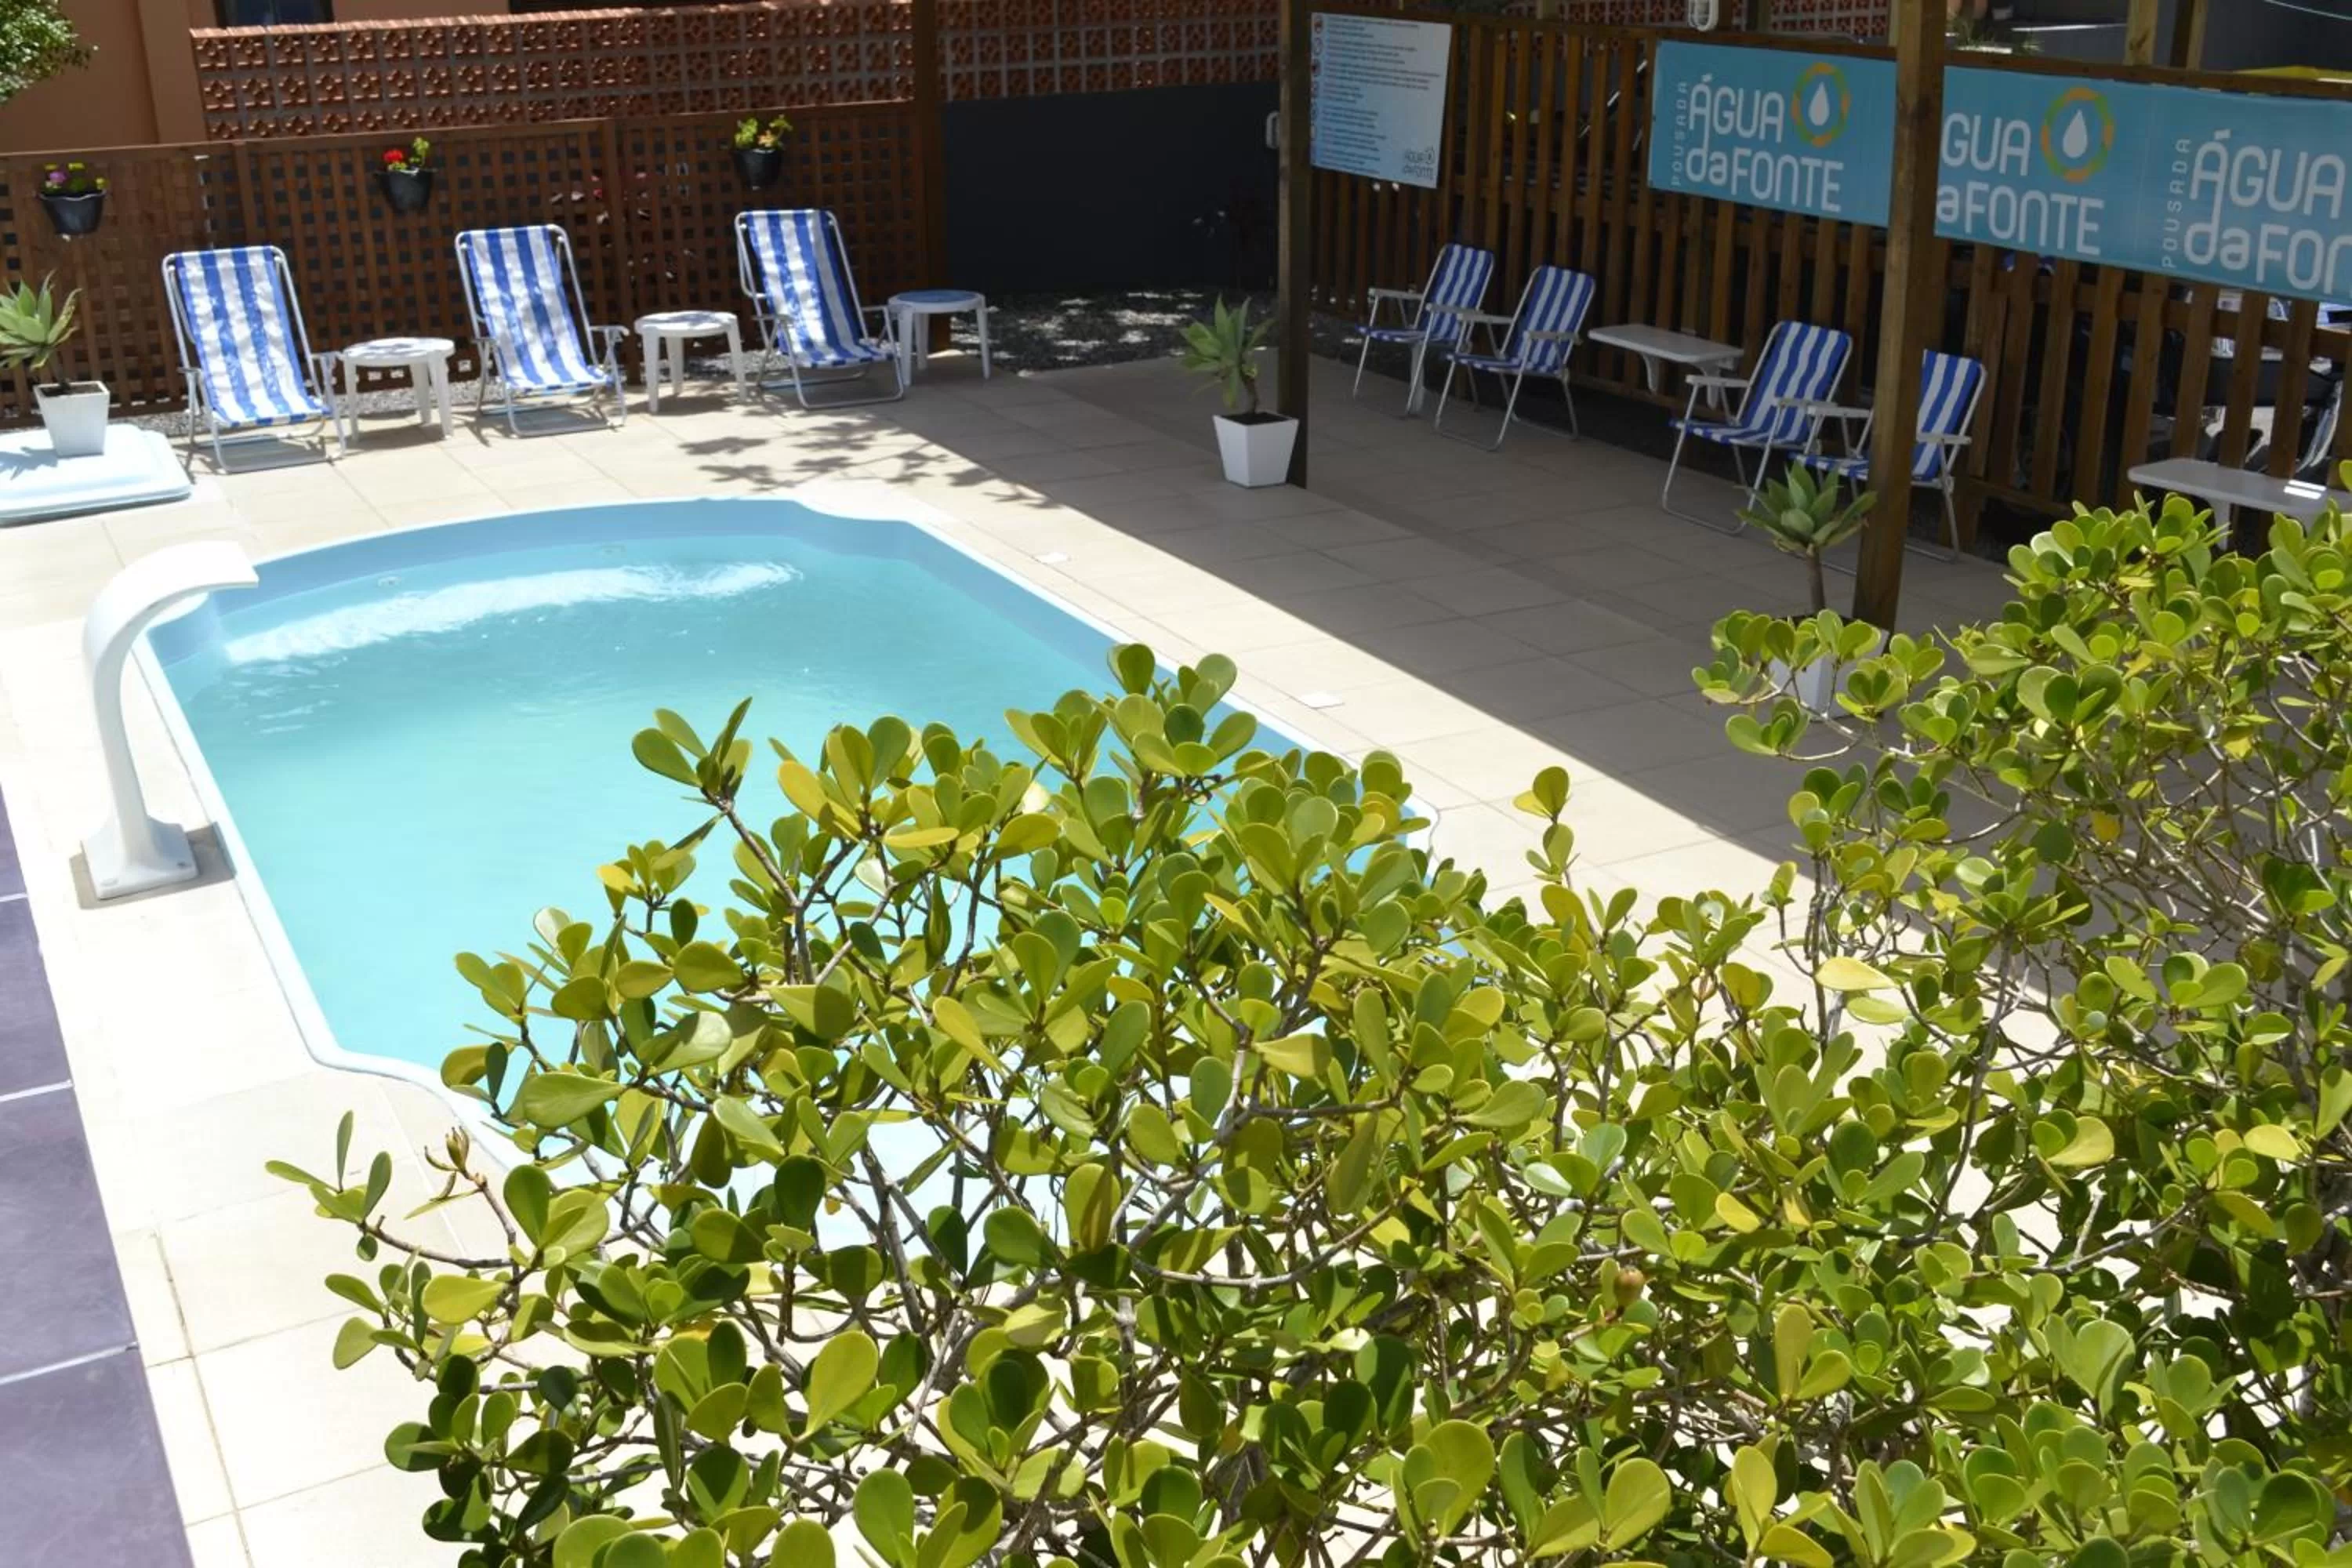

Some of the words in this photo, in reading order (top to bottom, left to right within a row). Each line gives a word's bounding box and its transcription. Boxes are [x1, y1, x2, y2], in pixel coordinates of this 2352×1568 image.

[1670, 82, 1689, 187] POUSADA
[1687, 73, 1784, 143] ÁGUA
[1940, 112, 2031, 176] GUA
[2161, 138, 2193, 267] POUSADA
[2188, 128, 2347, 220] ÁGUA
[1936, 180, 2104, 256] aFONTE
[2183, 217, 2352, 297] daFON
